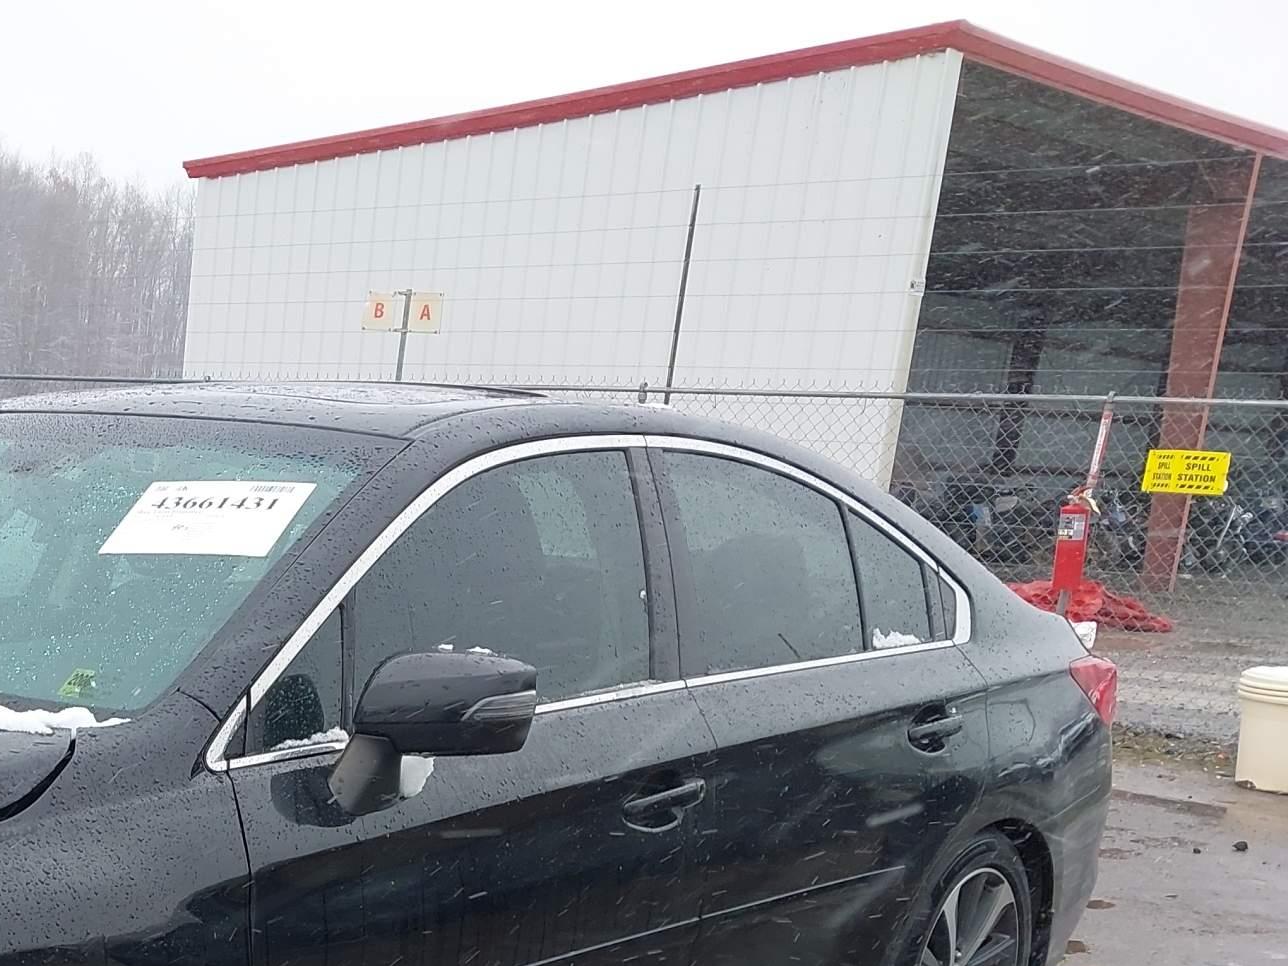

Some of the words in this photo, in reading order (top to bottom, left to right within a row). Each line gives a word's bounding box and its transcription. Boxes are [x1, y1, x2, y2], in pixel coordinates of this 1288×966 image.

[374, 302, 384, 319] B
[419, 304, 431, 321] A
[1185, 462, 1212, 471] SPILL
[1177, 473, 1216, 482] STATION
[151, 496, 279, 510] 43661431
